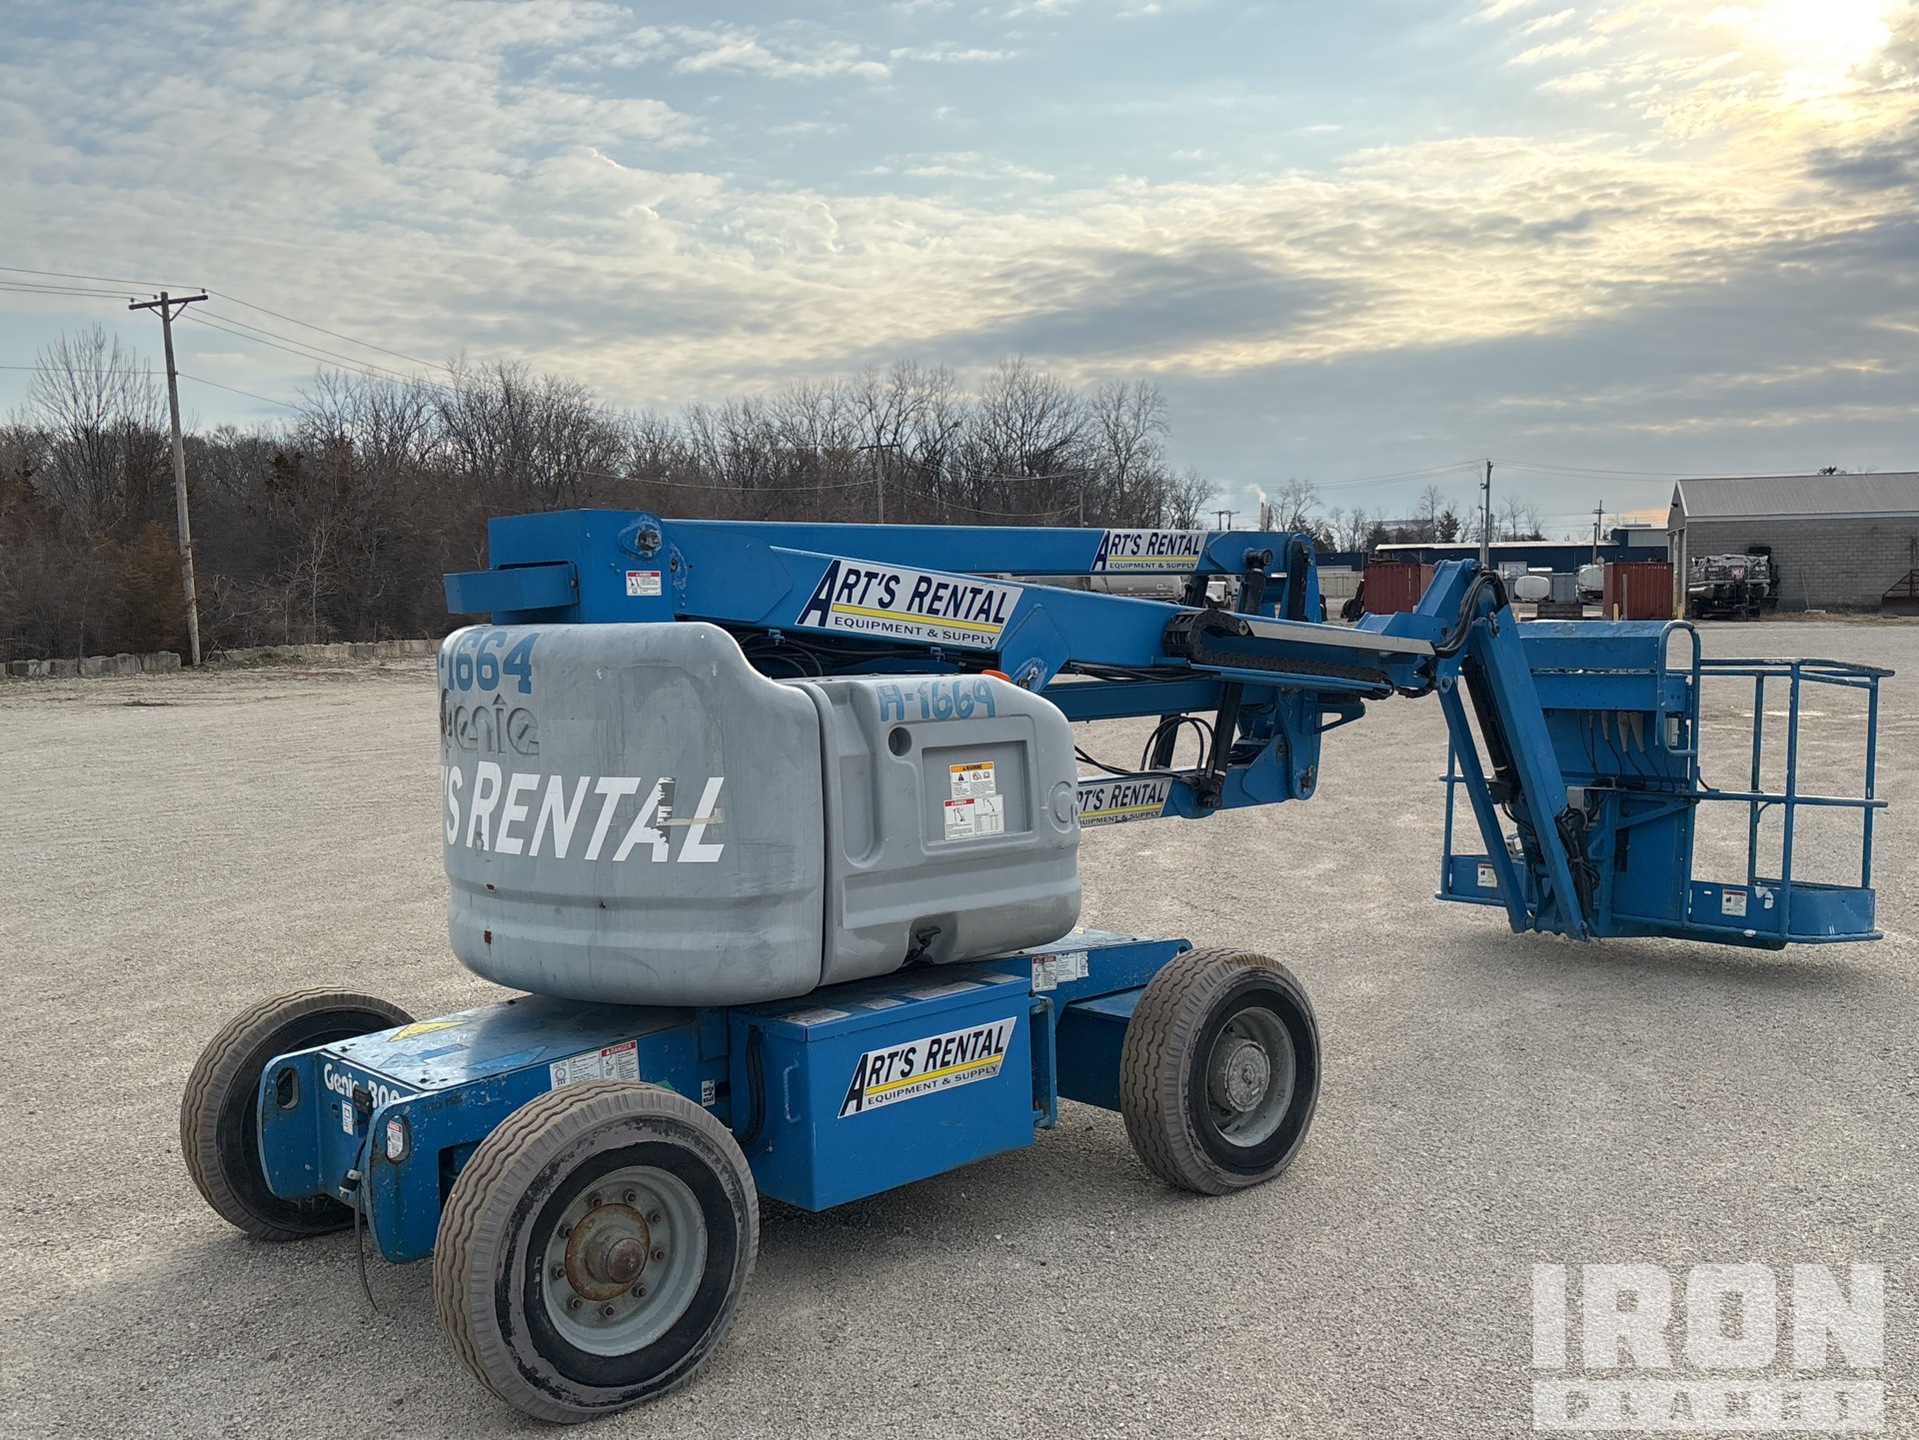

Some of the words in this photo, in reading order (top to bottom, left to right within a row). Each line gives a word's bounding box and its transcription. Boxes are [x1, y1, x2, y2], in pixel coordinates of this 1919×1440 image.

[1091, 530, 1142, 571] ART'S
[1146, 532, 1200, 555] RENTAL
[796, 559, 901, 627] ART'S
[906, 575, 1007, 624] RENTAL
[834, 616, 923, 636] EQUIPMENT
[927, 627, 938, 638] &
[942, 630, 996, 645] SUPPLY
[465, 760, 725, 863] RENTAL
[1109, 781, 1164, 809] RENTAL
[1129, 810, 1160, 819] SUPPLY
[610, 1042, 632, 1054] DANGER
[324, 1062, 360, 1099] Geni
[839, 1046, 917, 1117] ART'S
[923, 1026, 1004, 1073] RENTAL
[868, 1080, 938, 1105] EQUIPMENT
[942, 1077, 951, 1086] &
[954, 1064, 998, 1082] SUPPLY
